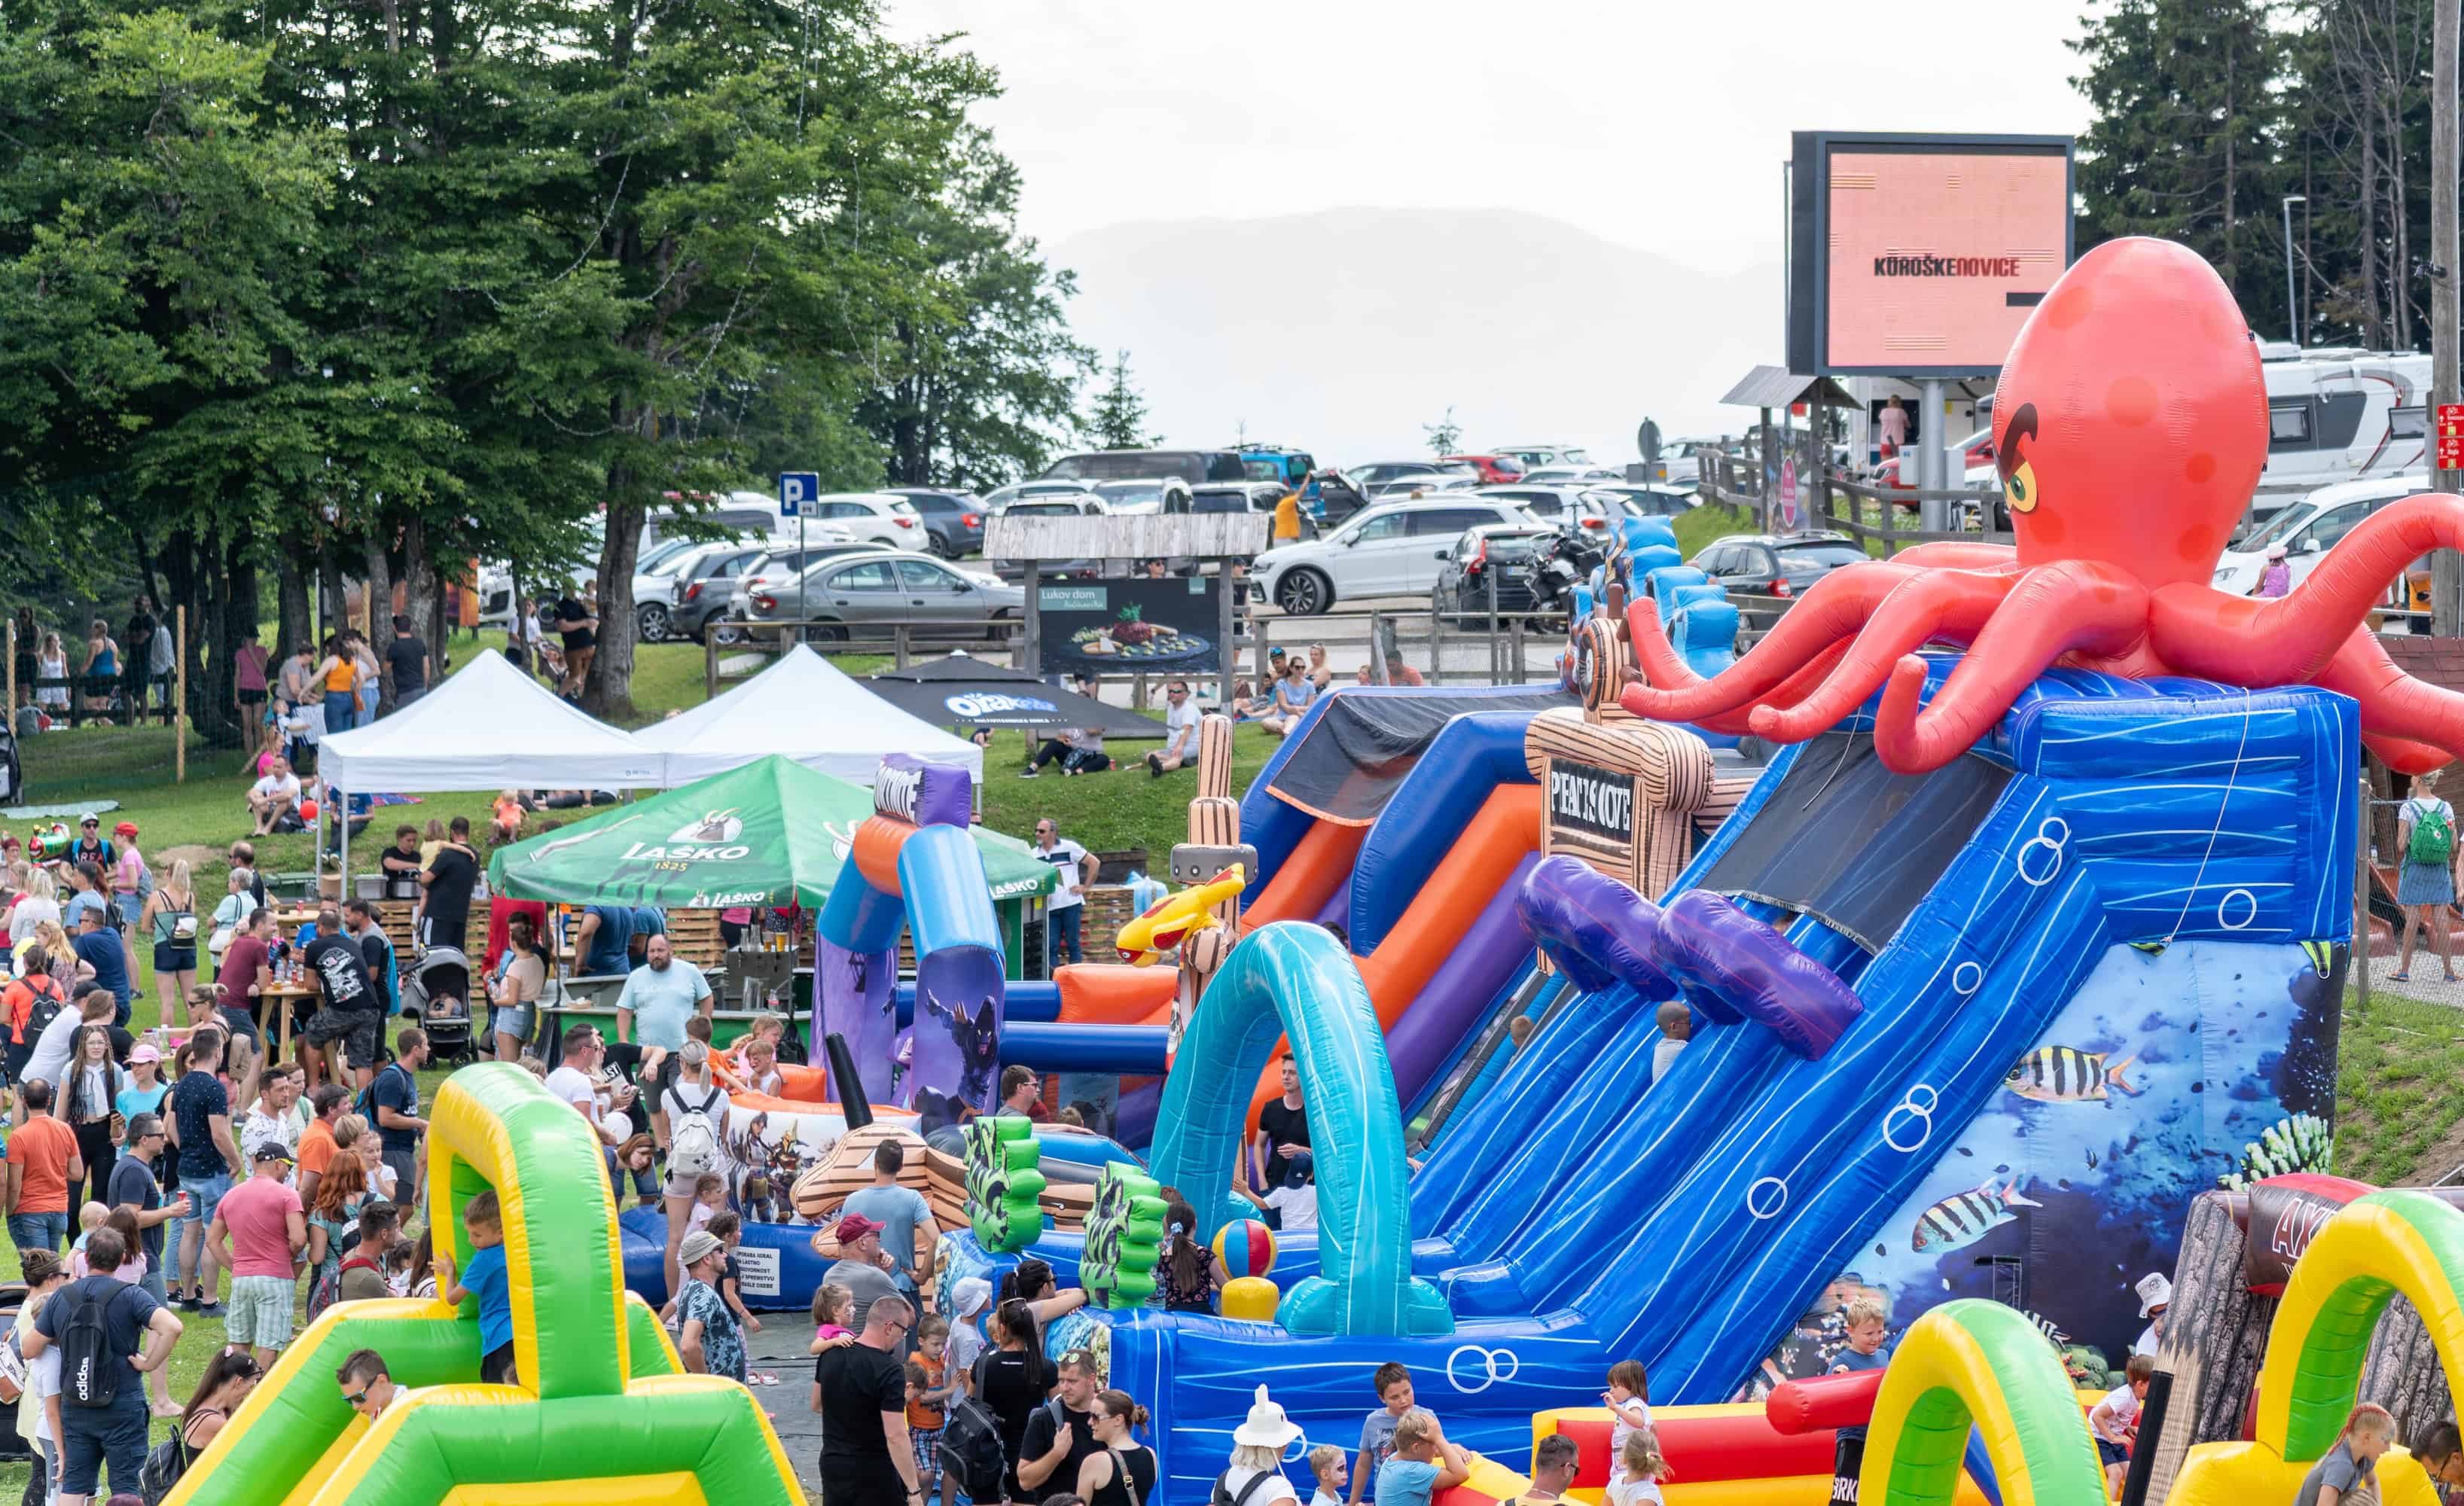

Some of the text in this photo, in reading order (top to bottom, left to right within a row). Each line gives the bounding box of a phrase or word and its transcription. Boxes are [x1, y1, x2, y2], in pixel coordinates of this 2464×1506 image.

[784, 478, 804, 510] P
[1041, 590, 1096, 599] Lukov dom
[654, 861, 688, 872] 1825
